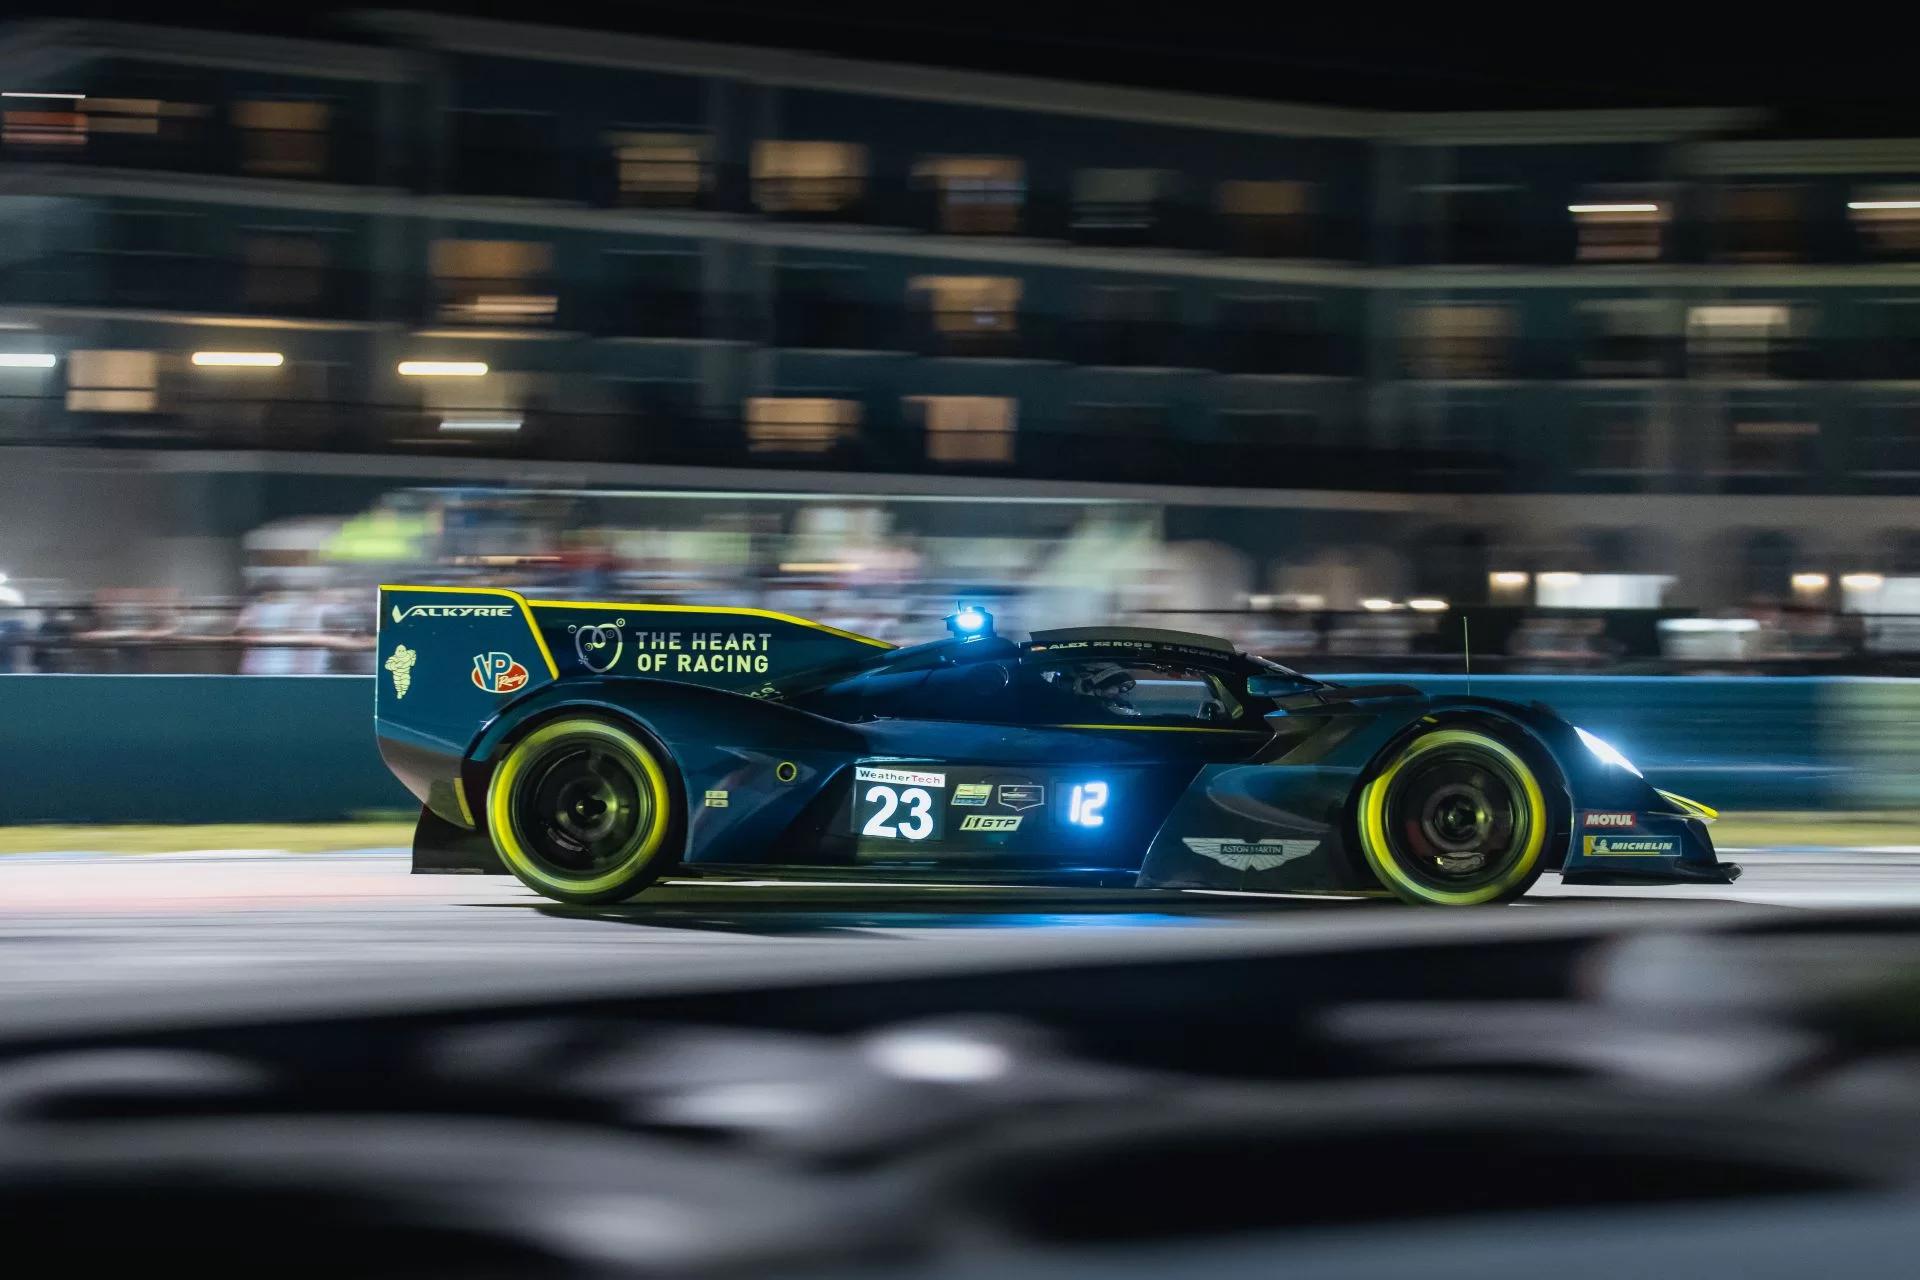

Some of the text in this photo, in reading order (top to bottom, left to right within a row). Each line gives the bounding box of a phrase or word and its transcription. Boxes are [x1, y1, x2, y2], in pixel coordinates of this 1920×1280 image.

[392, 605, 515, 623] VALKYRIE
[635, 631, 772, 651] THE HEART
[1049, 641, 1089, 650] ALEX
[473, 652, 513, 691] VP
[637, 653, 769, 673] OF RACING
[860, 769, 941, 785] WeatherTech
[862, 785, 934, 840] 23
[1070, 782, 1108, 826] 12
[982, 819, 1017, 828] GTP
[1586, 814, 1633, 826] MOTUL
[1222, 845, 1282, 854] ASTON MARTIN
[1611, 842, 1673, 850] MICHELIN
